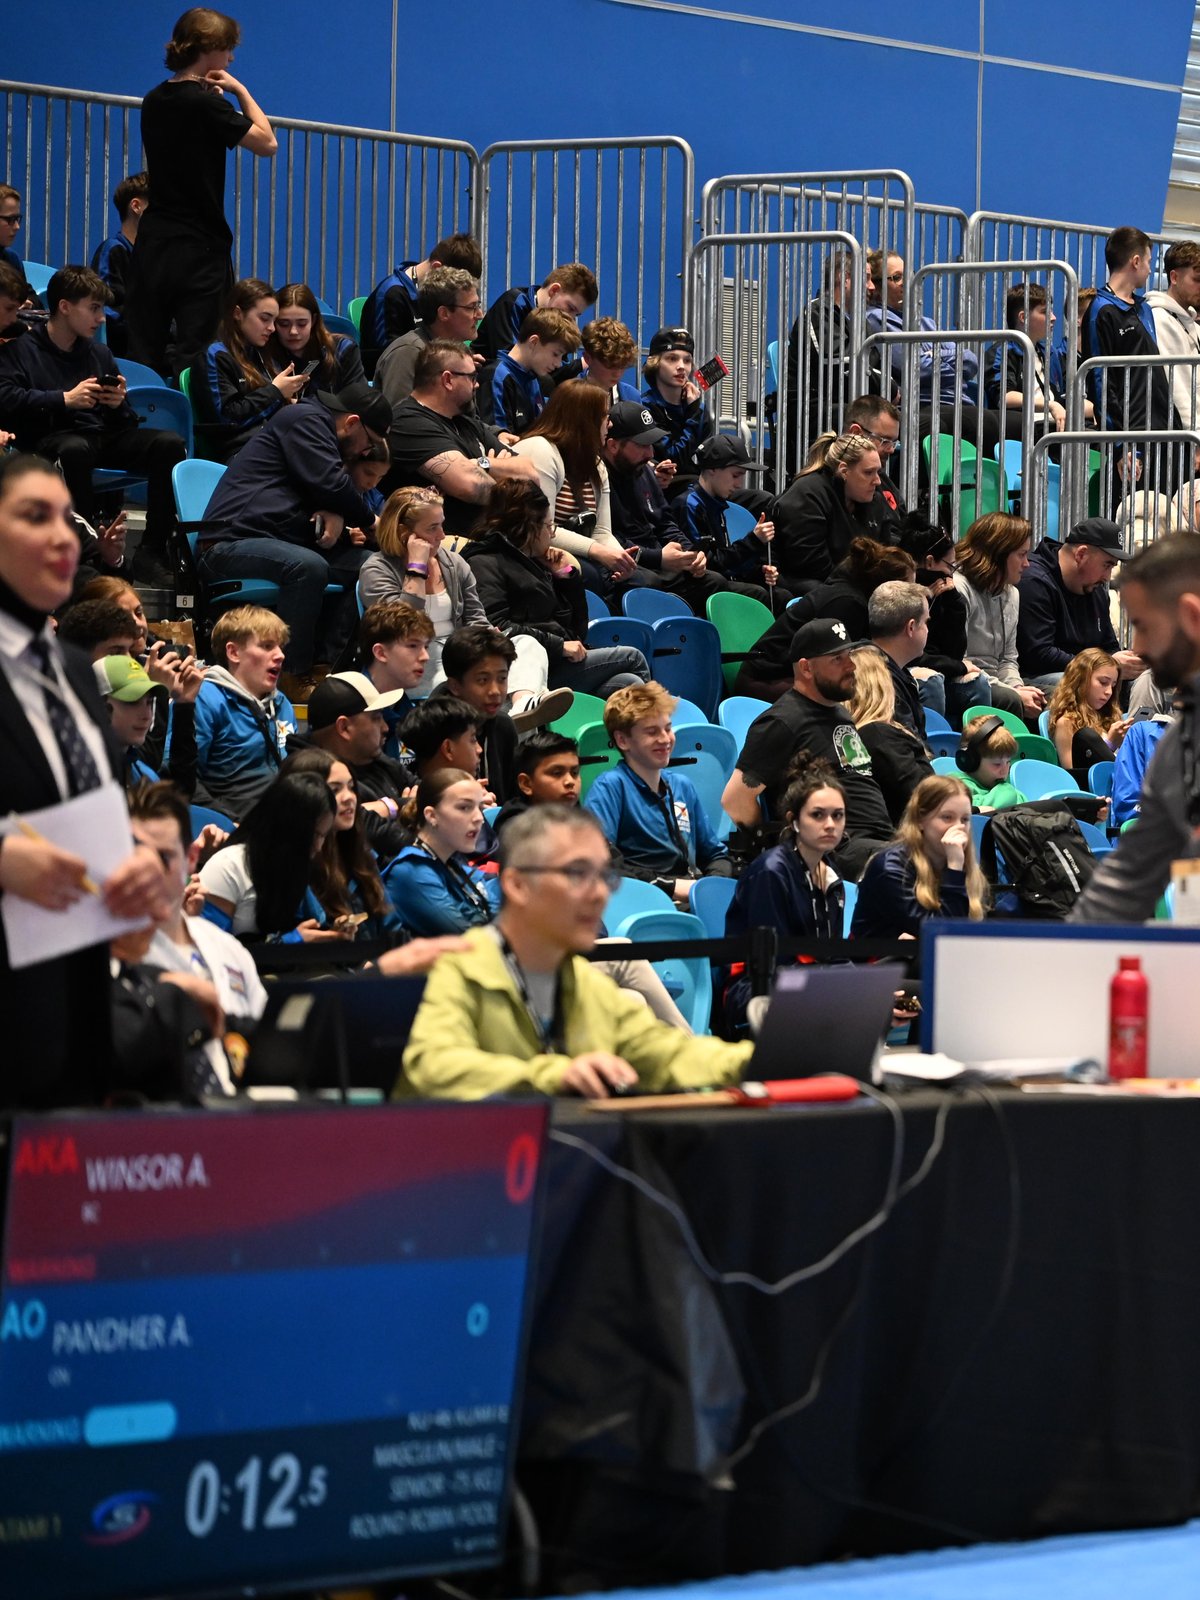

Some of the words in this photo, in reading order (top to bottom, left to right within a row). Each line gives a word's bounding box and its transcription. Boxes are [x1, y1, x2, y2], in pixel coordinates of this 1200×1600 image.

[182, 596, 188, 607] 6
[15, 1135, 79, 1175] AKA
[86, 1153, 184, 1193] WINSOR
[506, 1134, 539, 1204] 0
[1, 1299, 47, 1341] AO
[53, 1313, 166, 1354] PANDHER
[466, 1302, 490, 1337] 0
